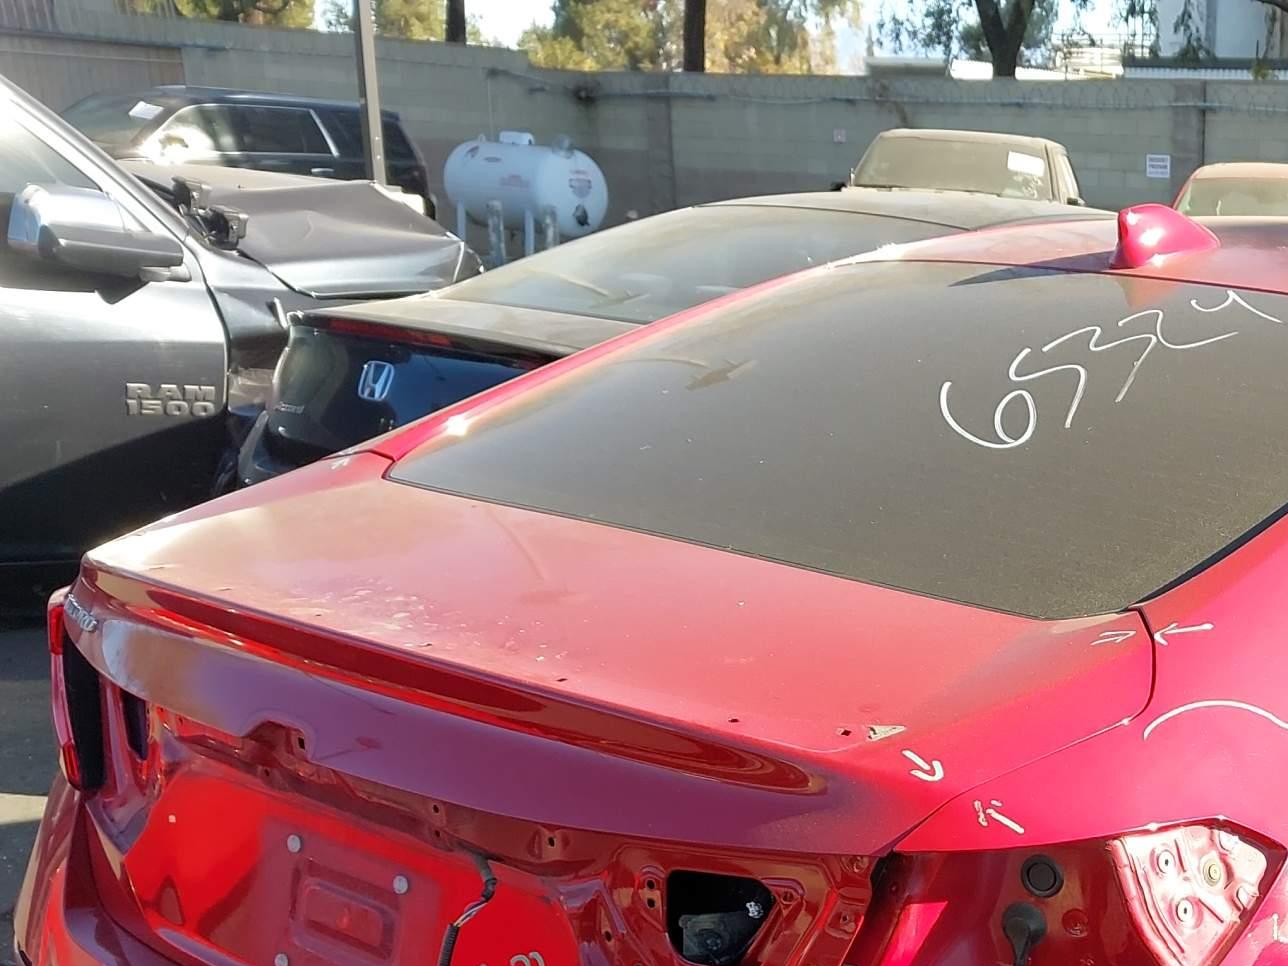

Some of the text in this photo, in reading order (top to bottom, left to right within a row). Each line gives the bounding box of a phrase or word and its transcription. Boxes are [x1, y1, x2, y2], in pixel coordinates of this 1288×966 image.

[940, 290, 1284, 449] 65324
[126, 383, 216, 401] RAM
[126, 400, 215, 416] 1500
